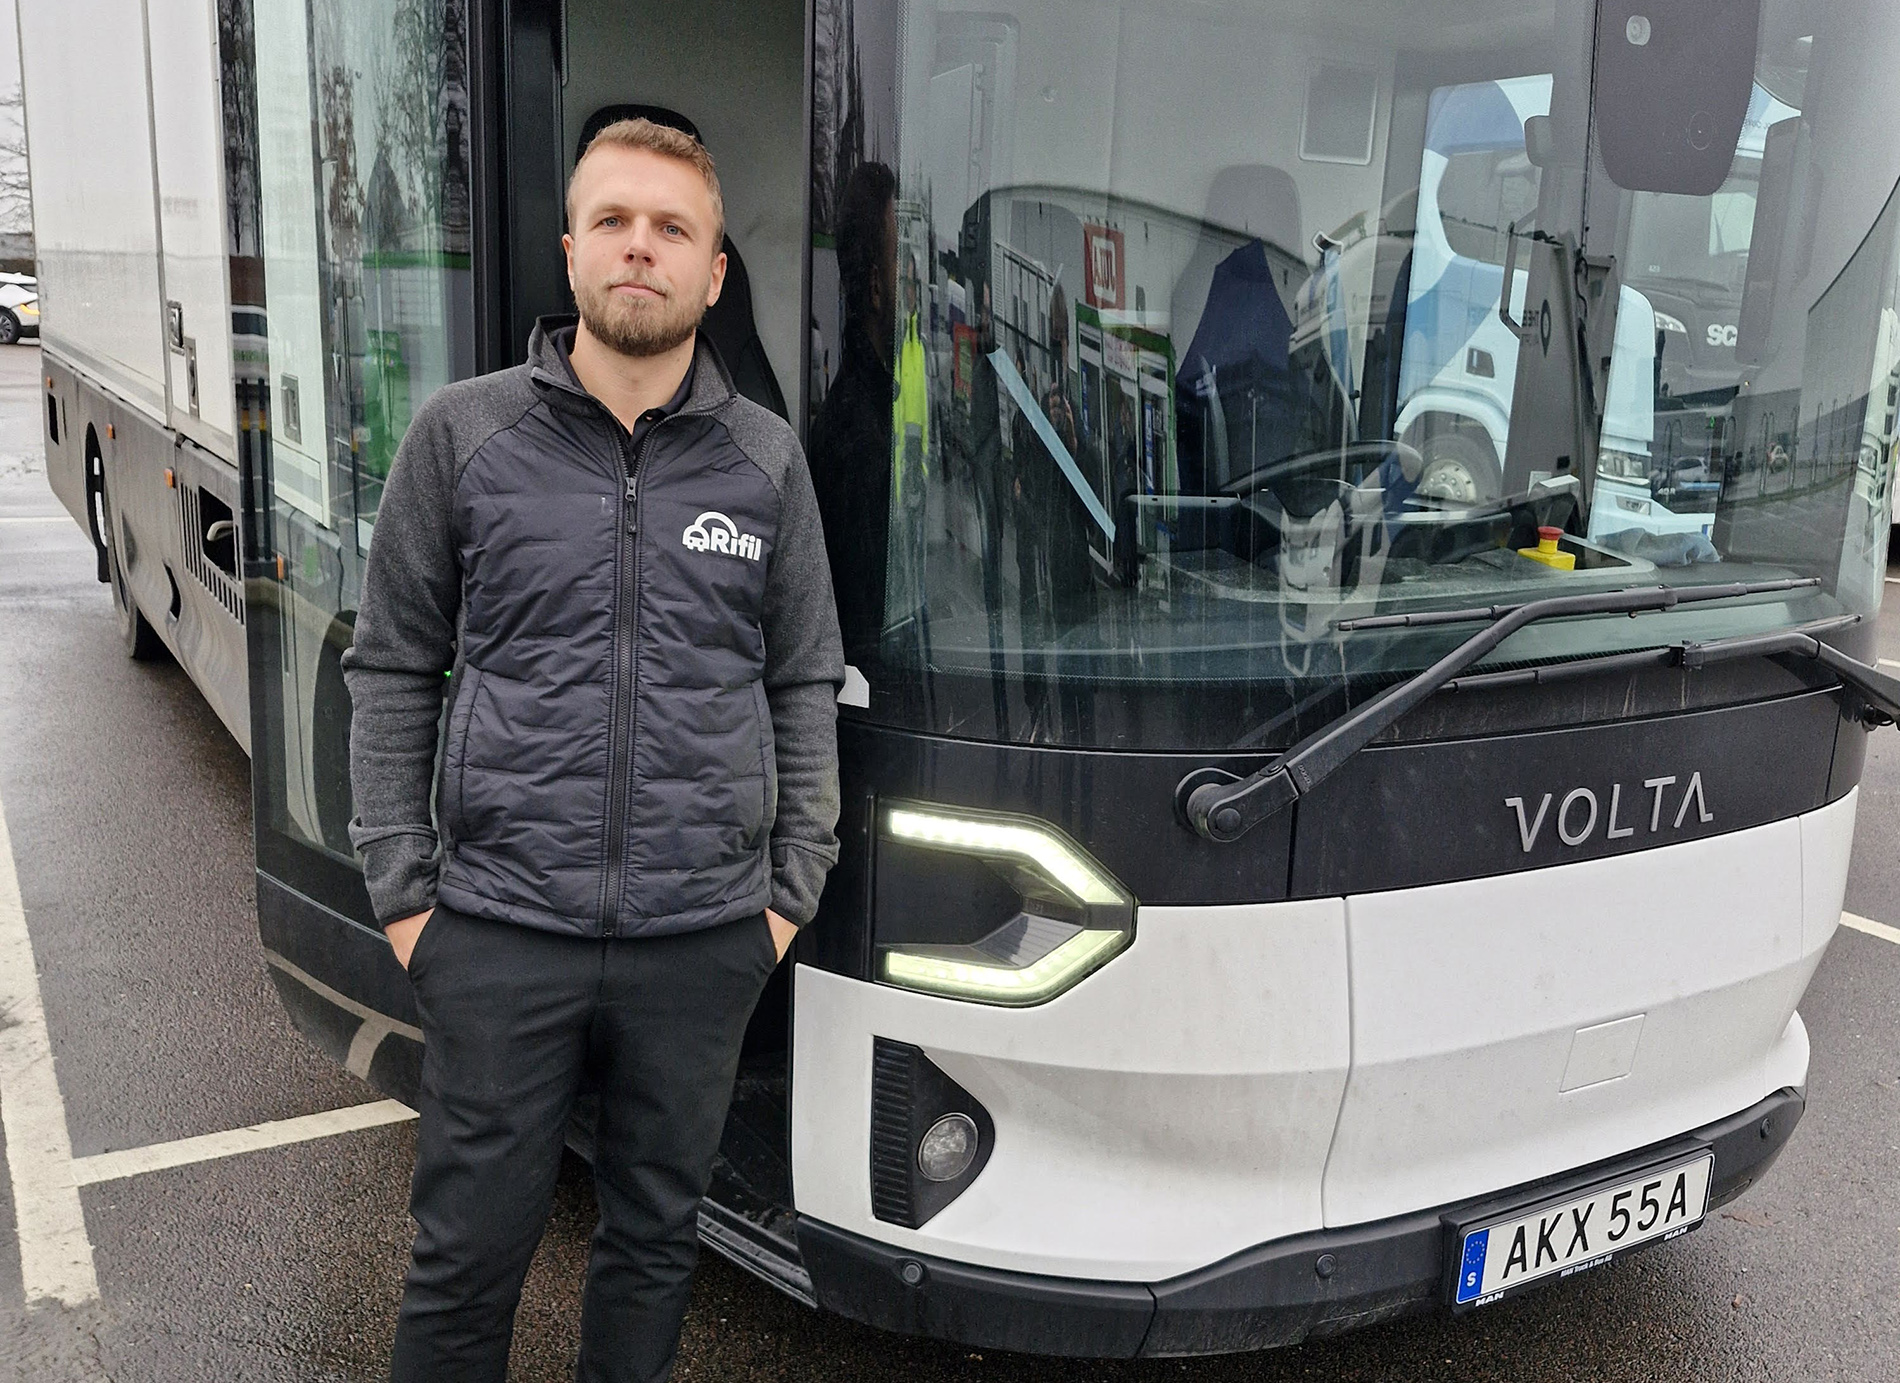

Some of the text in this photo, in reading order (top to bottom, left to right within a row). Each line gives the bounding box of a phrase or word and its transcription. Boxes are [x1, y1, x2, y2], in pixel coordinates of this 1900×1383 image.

[711, 527, 762, 561] Rifil
[1505, 772, 1713, 852] VOLTA
[1502, 1172, 1688, 1280] AKX 55A
[1664, 1226, 1688, 1241] MAN
[1466, 1271, 1477, 1287] S
[1475, 1292, 1504, 1307] MAN
